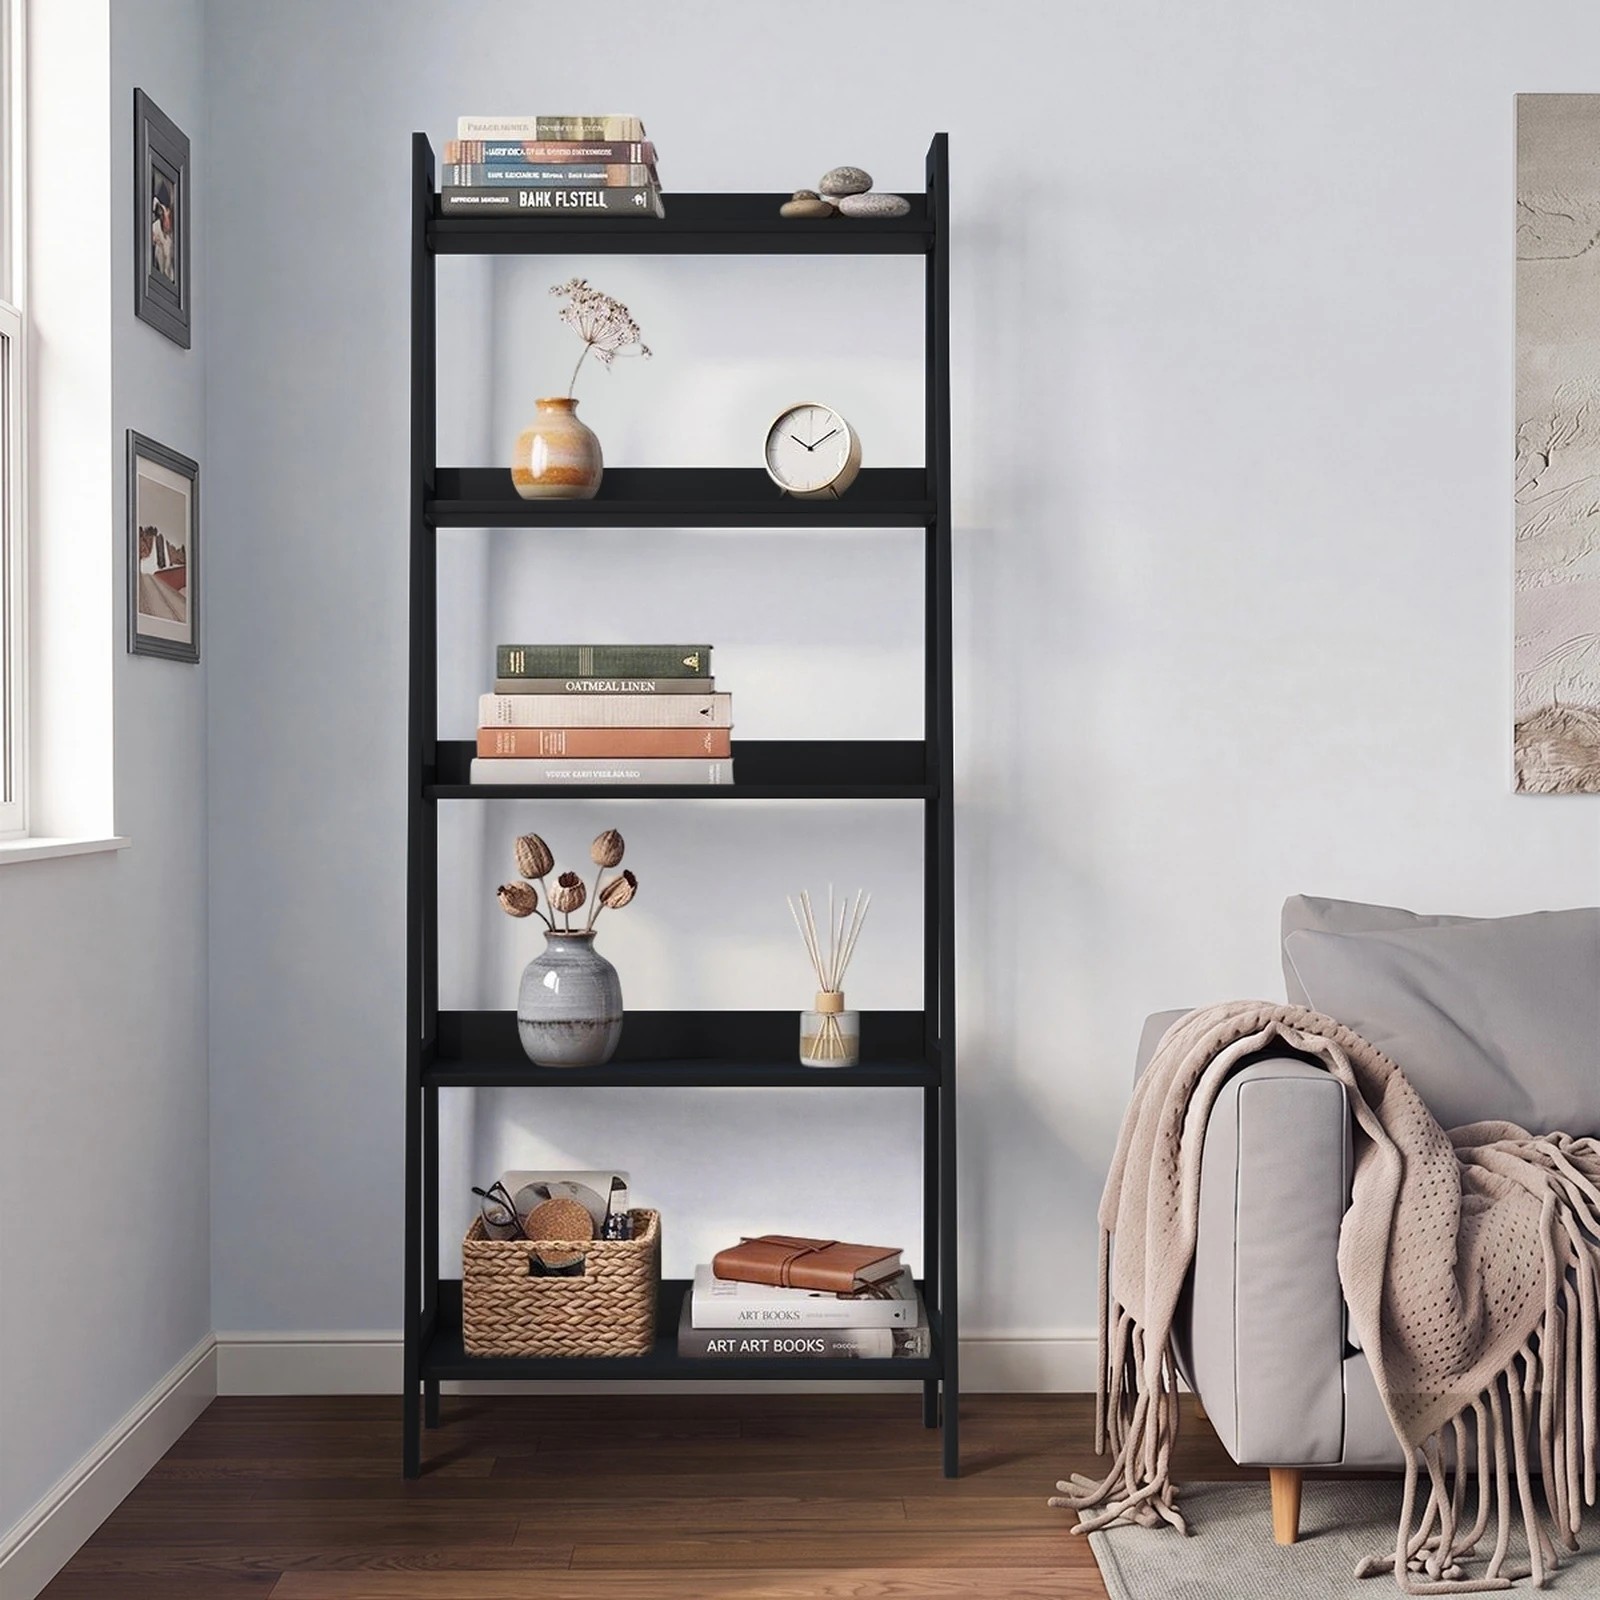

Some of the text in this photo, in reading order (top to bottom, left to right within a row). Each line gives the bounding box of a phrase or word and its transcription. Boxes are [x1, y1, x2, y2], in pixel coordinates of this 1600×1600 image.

[565, 681, 656, 691] OATMEAL LINEN
[738, 1311, 761, 1320] ART
[762, 1311, 800, 1320] BOOKS
[706, 1339, 736, 1352] ART
[740, 1339, 770, 1352] ART
[773, 1339, 825, 1352] BOOKS
